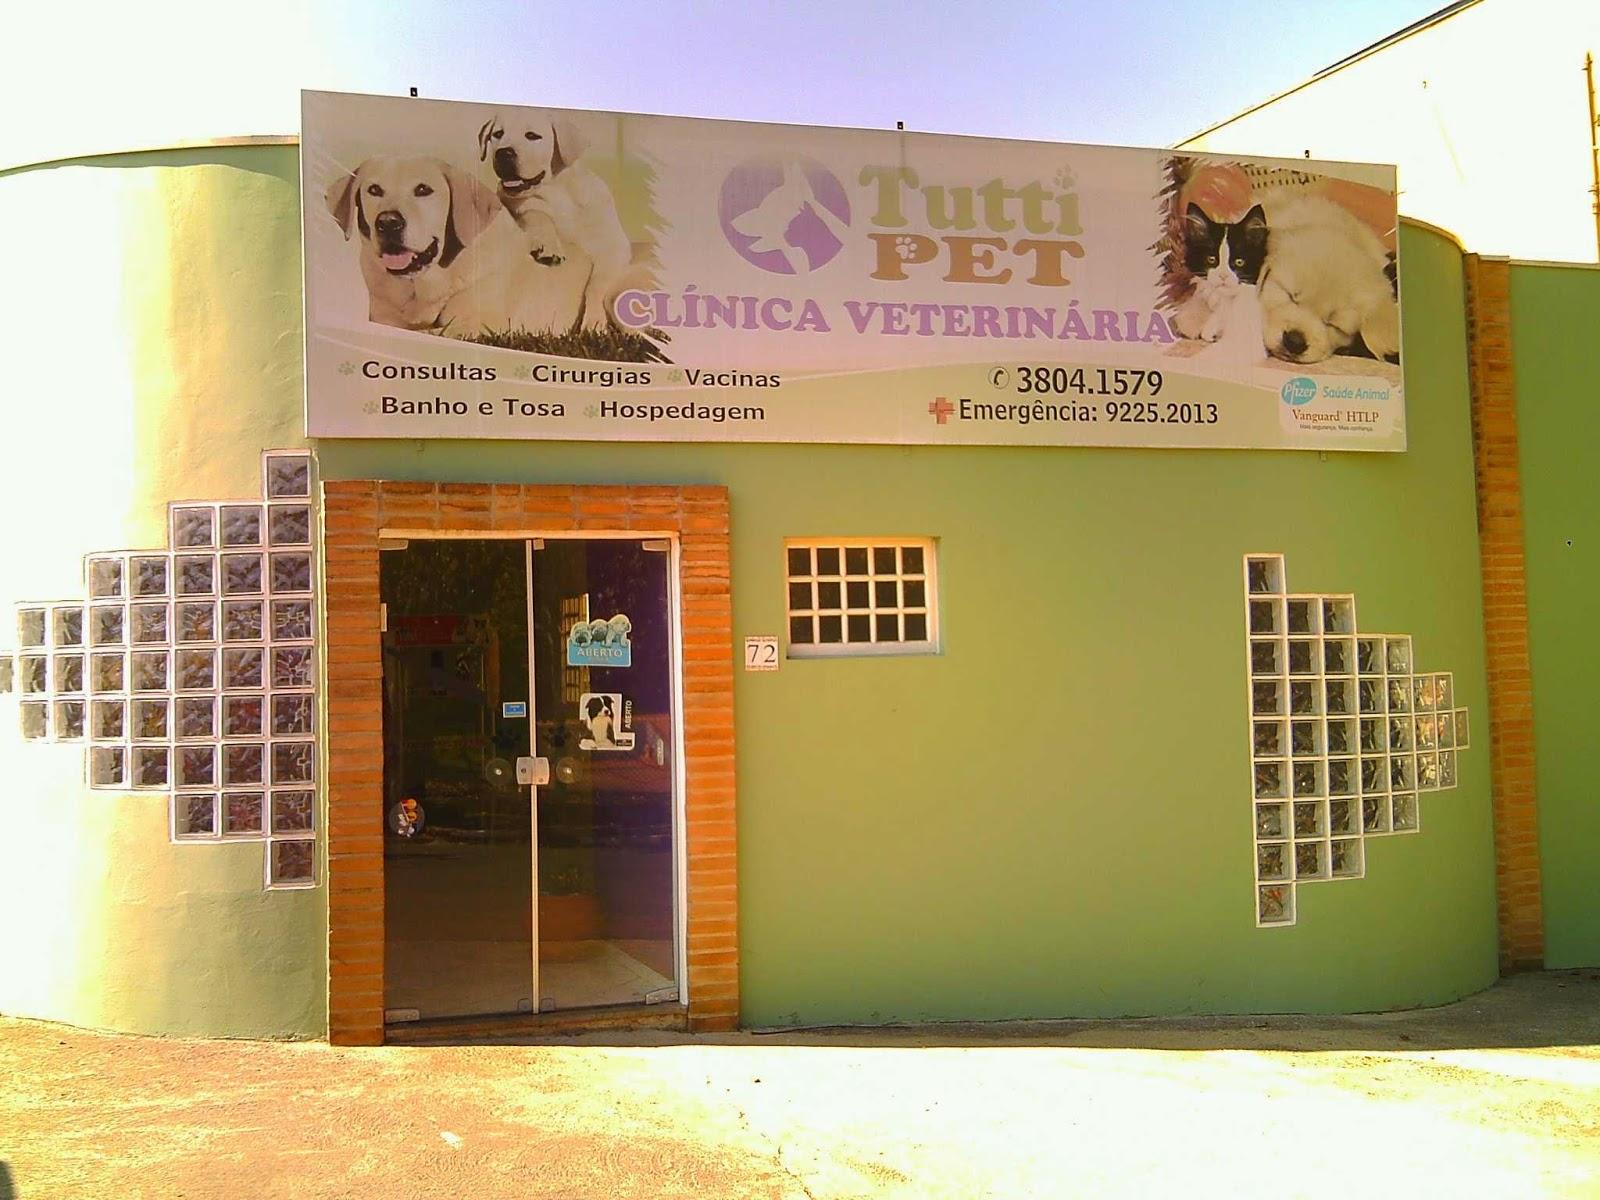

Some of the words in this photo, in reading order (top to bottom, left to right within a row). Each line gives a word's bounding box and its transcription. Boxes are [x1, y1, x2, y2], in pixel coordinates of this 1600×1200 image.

[858, 165, 1084, 236] Tutti
[867, 233, 1085, 287] PET
[617, 284, 832, 332] CLÍNICA
[843, 300, 1177, 344] VETERINÁRIA
[362, 361, 497, 381] Consultas
[532, 365, 651, 387] Cirurgias
[685, 369, 781, 388] Vacinas
[1016, 367, 1163, 396] 3804.1579
[1284, 381, 1316, 405] Pfizer
[1322, 386, 1354, 399] Saúde
[1354, 387, 1390, 400] Animal
[381, 396, 468, 416] Banho
[478, 402, 494, 416] e
[502, 398, 566, 417] Tosa
[600, 401, 765, 422] Hospedagem
[959, 399, 1098, 424] Emergência:
[1105, 402, 1219, 424] 9225.2013
[1346, 411, 1379, 423] HTLP
[577, 648, 623, 657] ABERTO
[748, 644, 776, 663] 72
[624, 700, 633, 729] ABERTO
